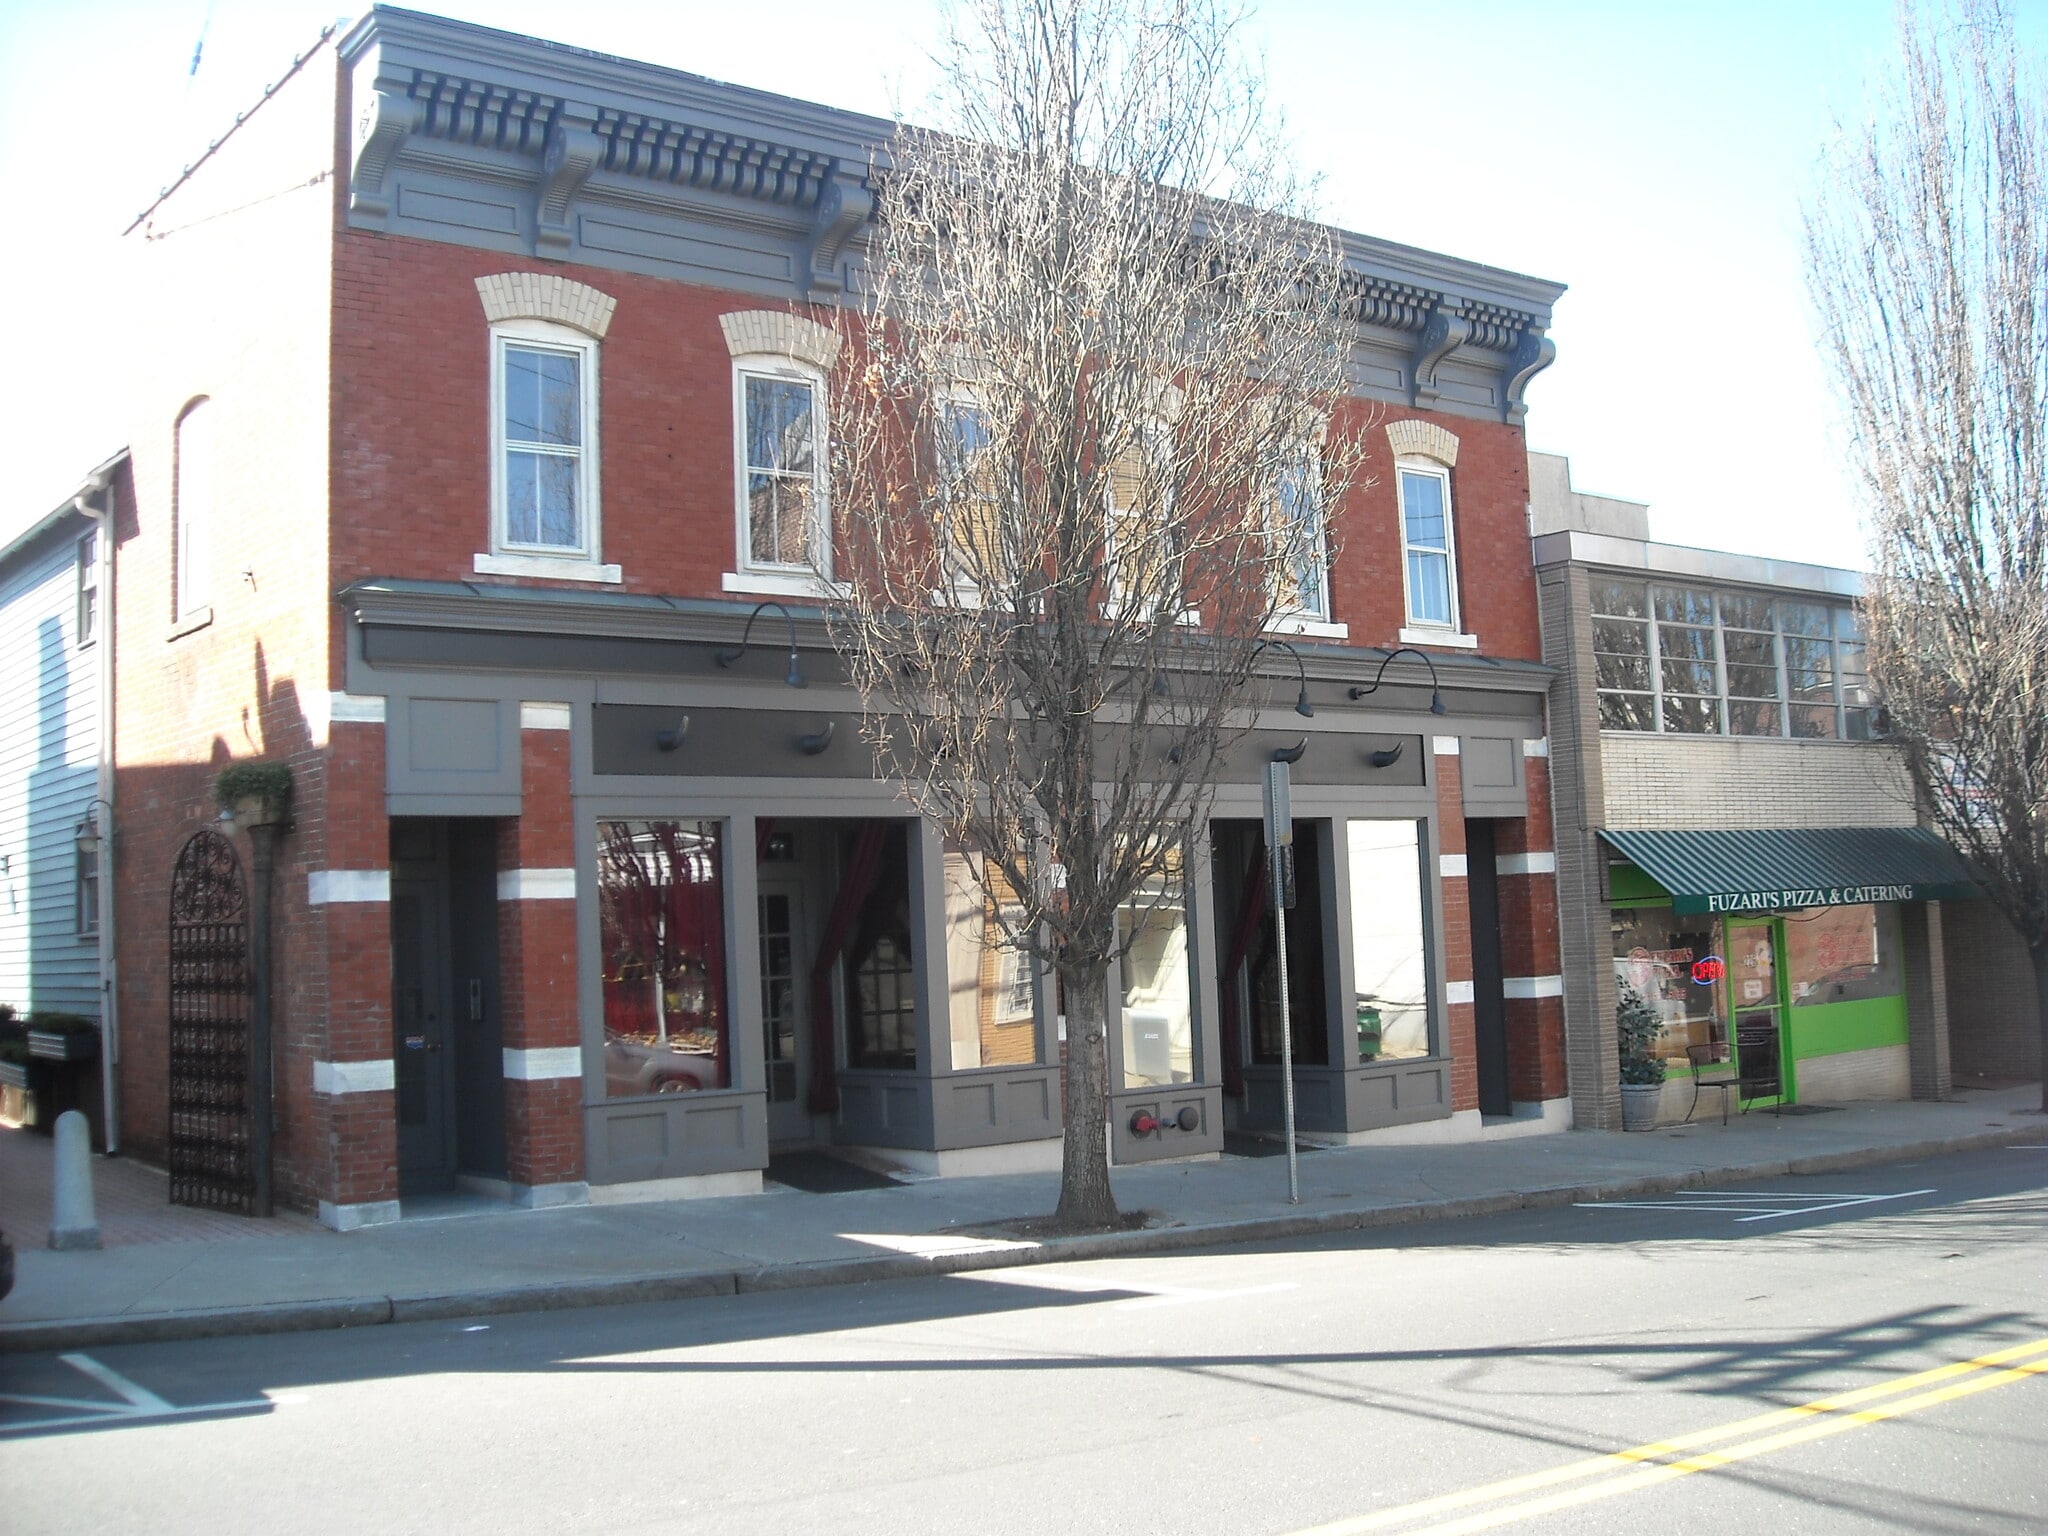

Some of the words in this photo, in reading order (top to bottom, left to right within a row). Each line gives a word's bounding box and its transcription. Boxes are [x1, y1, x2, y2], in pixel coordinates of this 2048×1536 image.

[1708, 891, 1780, 912] FUZARI'S
[1783, 889, 1824, 907] PIZZA
[1828, 889, 1841, 904] &
[1843, 884, 1913, 903] CATERING
[1691, 961, 1726, 980] OPEN
